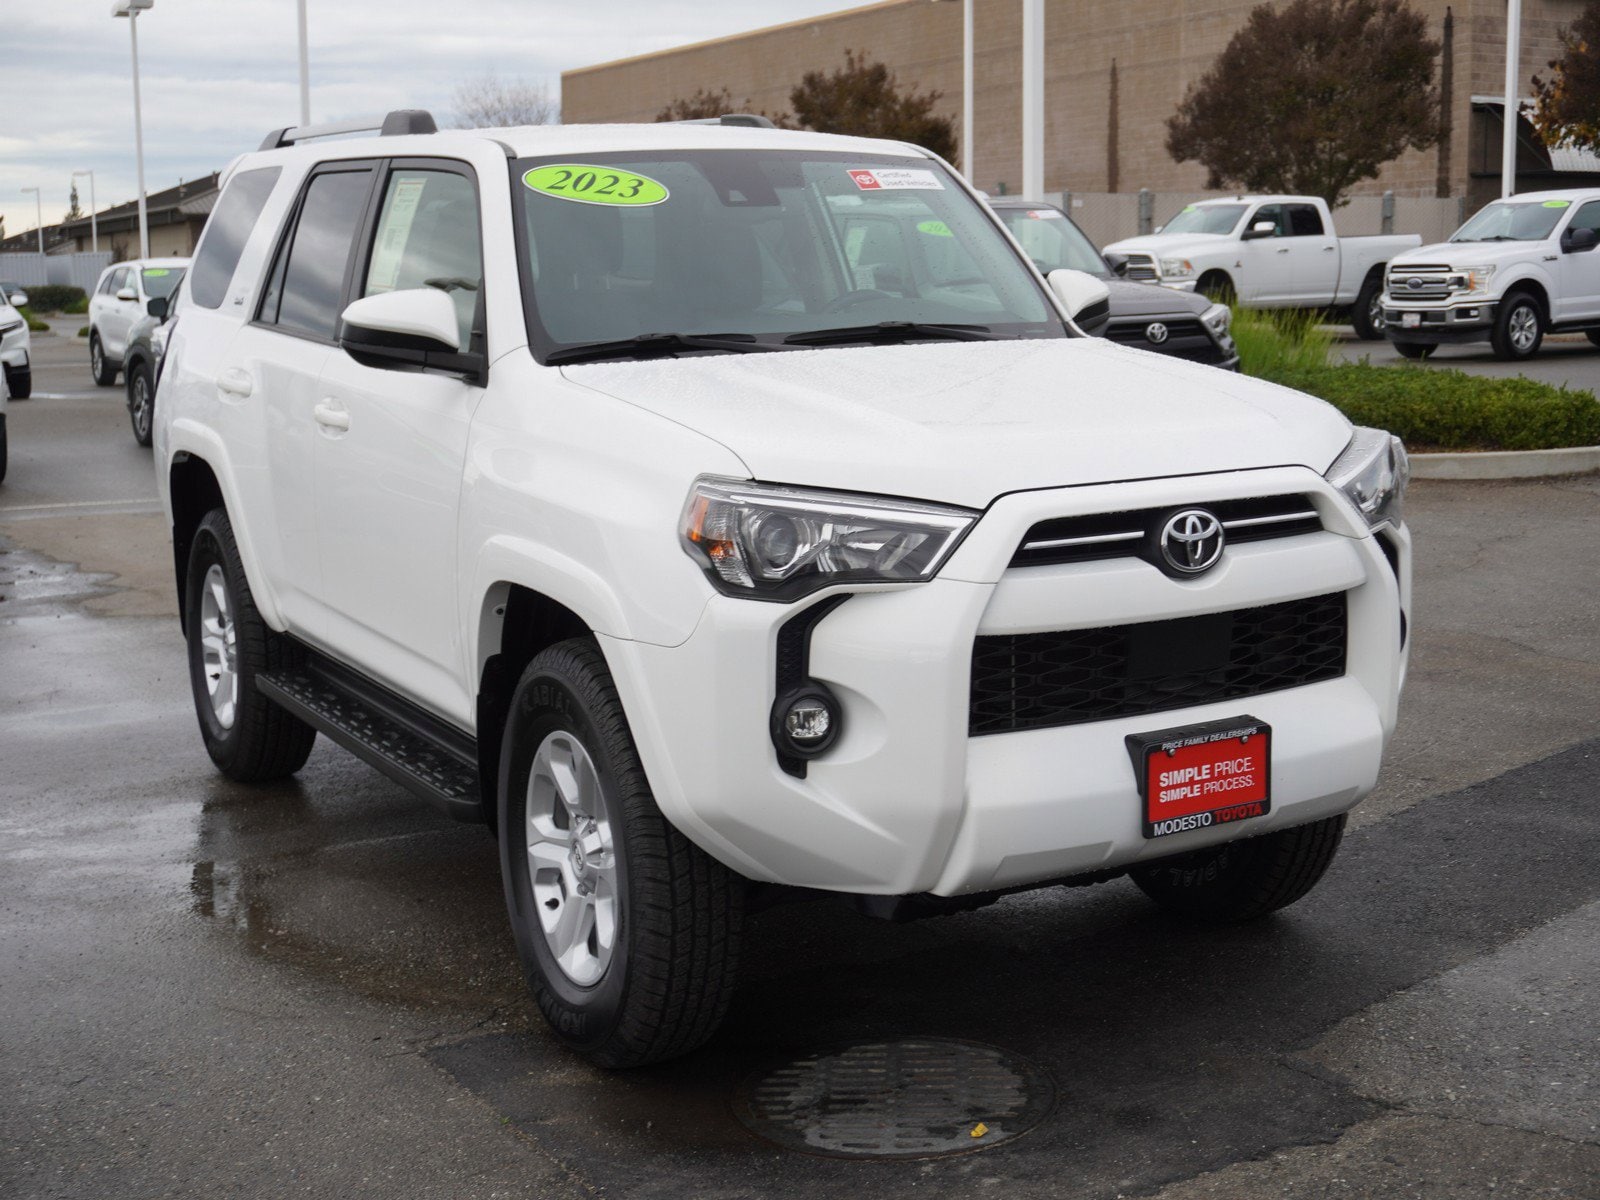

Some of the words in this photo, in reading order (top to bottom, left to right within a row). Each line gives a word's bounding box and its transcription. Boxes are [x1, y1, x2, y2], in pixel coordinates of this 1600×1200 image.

[545, 169, 644, 199] 2023
[1162, 741, 1183, 751] PRICE
[1184, 736, 1210, 747] FAMILY
[1210, 728, 1258, 742] DEALERSHIPS
[1160, 765, 1211, 787] SIMPLE
[1214, 757, 1255, 777] PRICE.
[1159, 785, 1201, 803] SIMPLE
[1203, 774, 1255, 795] PROCESS.
[1153, 812, 1212, 837] MODESTO
[1214, 803, 1263, 823] TOYOTA
